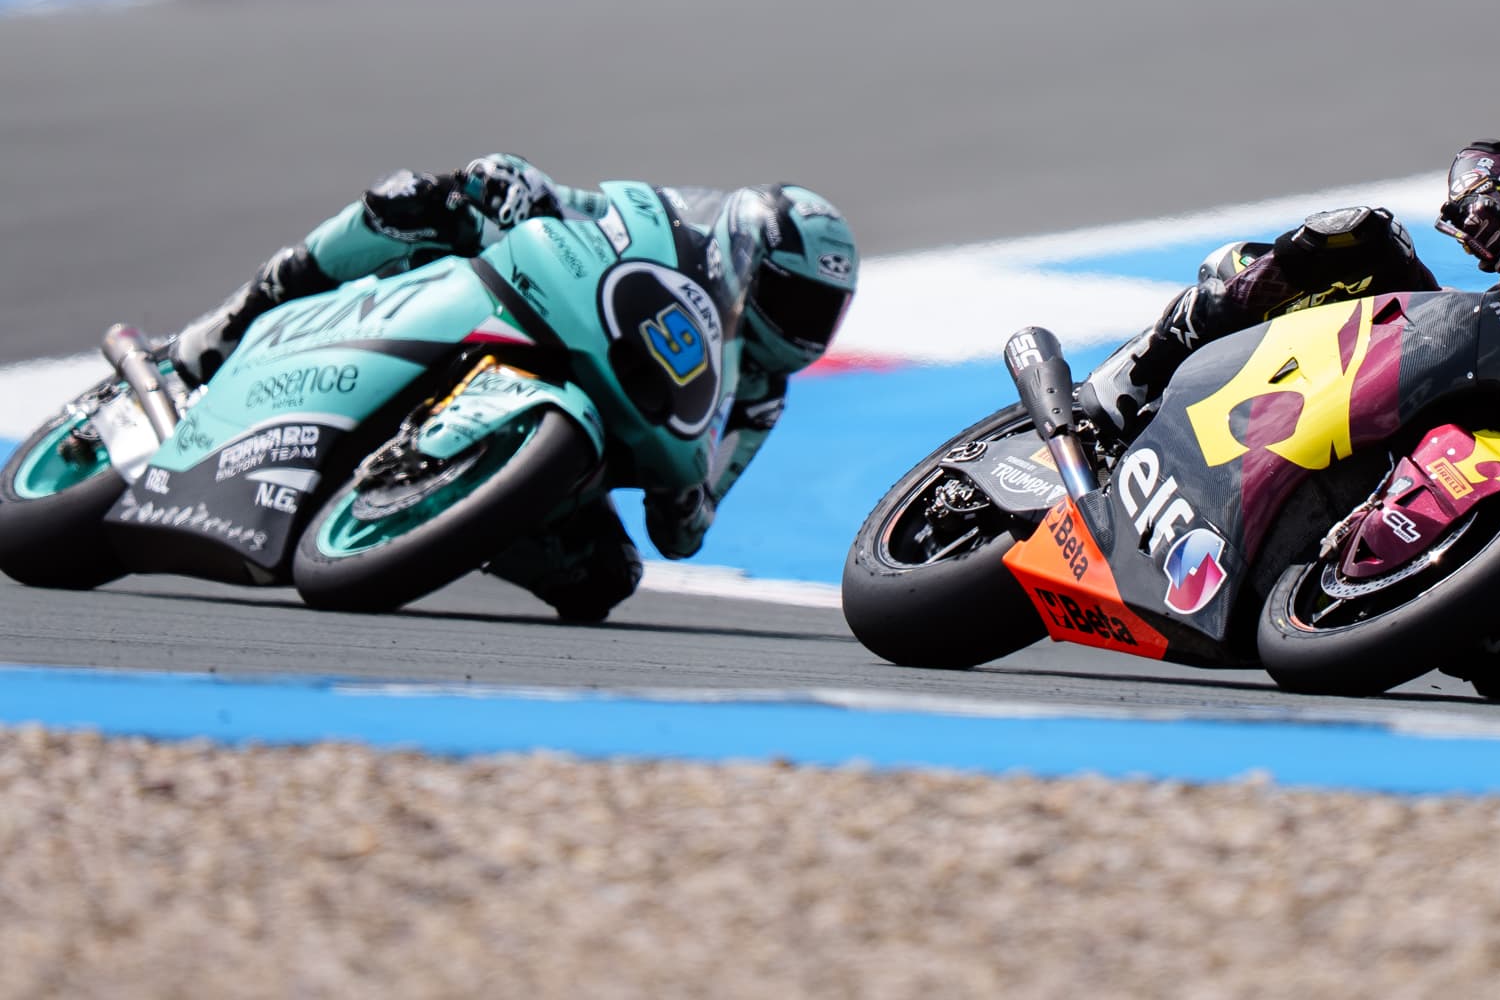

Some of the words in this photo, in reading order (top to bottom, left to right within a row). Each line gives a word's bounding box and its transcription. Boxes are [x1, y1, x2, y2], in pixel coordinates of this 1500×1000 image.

[680, 282, 720, 342] KLINT
[639, 302, 708, 386] 9
[246, 363, 359, 408] essence
[217, 425, 320, 470] FORWARD
[270, 445, 316, 463] TEAM
[991, 462, 1052, 498] TRIUMPH
[1118, 448, 1195, 554] elf
[1432, 463, 1468, 495] PIRELLI
[1055, 514, 1089, 582] Beta
[1058, 595, 1139, 647] Beta
